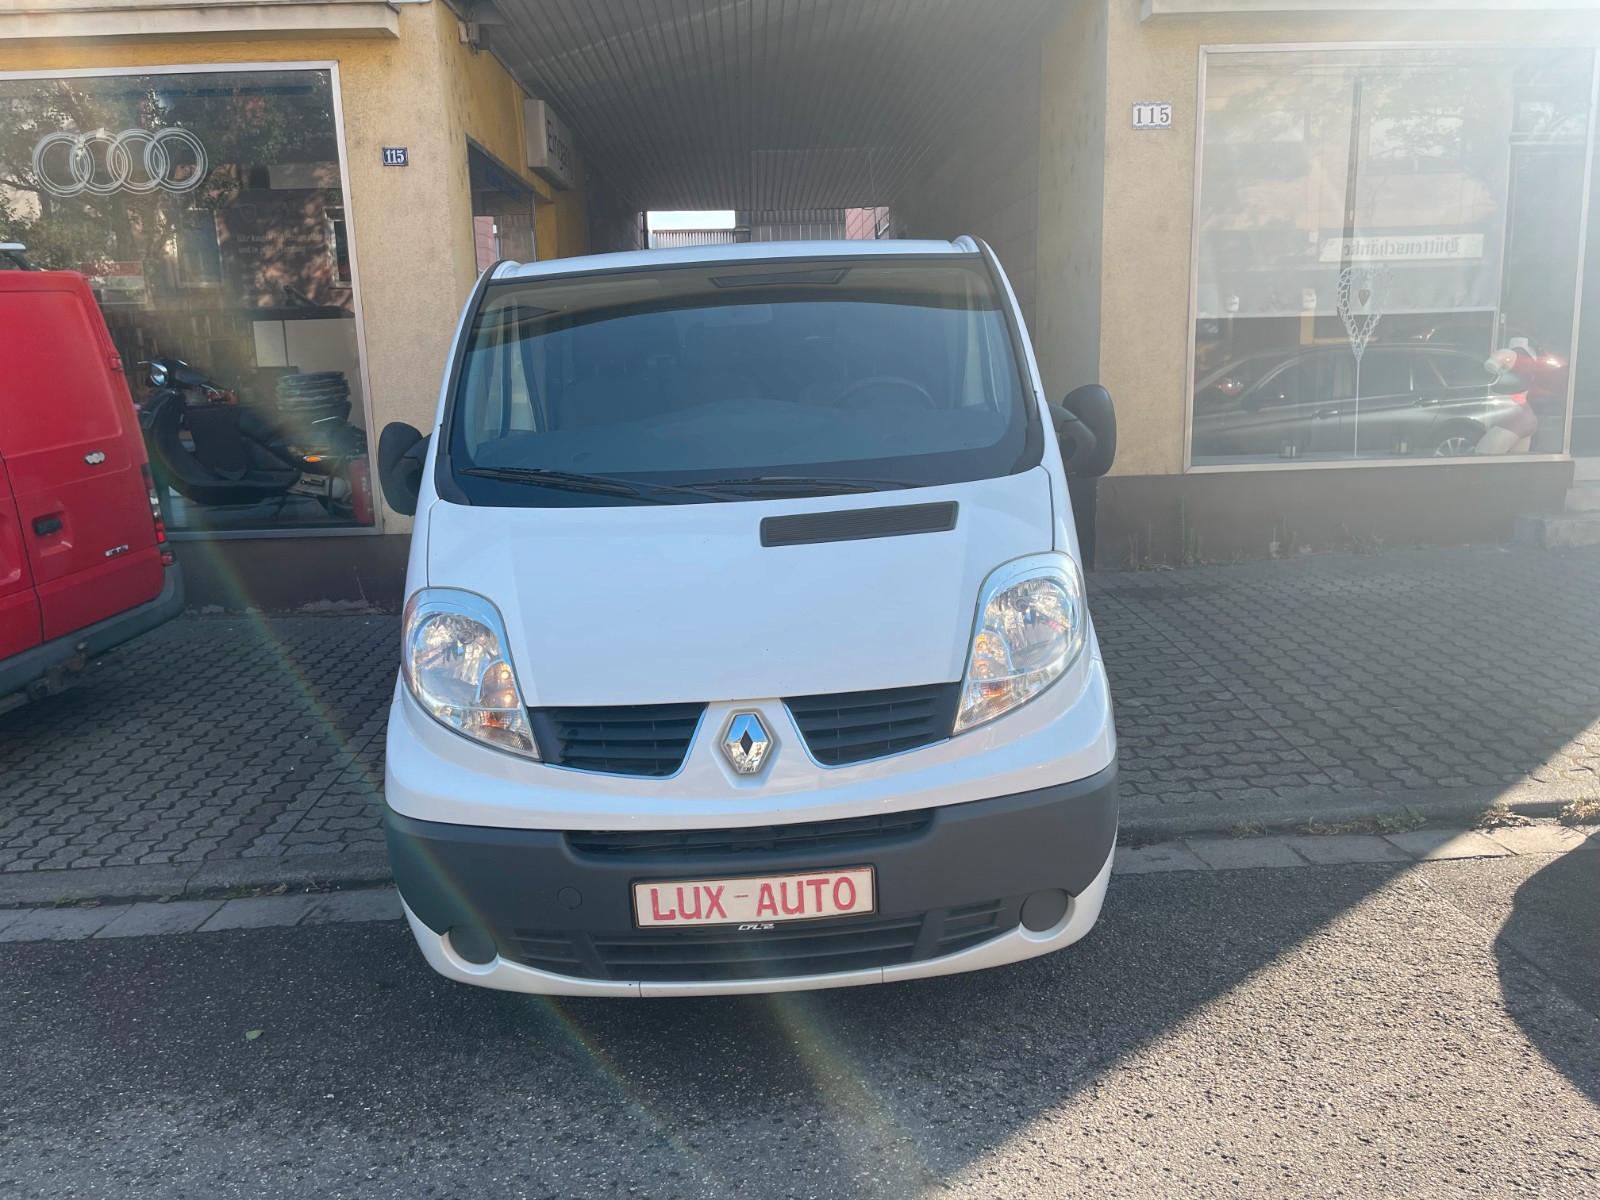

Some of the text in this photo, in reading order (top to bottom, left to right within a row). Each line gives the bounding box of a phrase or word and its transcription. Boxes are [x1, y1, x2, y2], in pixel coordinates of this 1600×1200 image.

[1135, 106, 1170, 124] 115
[384, 149, 405, 164] 115
[650, 885, 728, 921] LUX
[756, 876, 857, 918] AUTO
